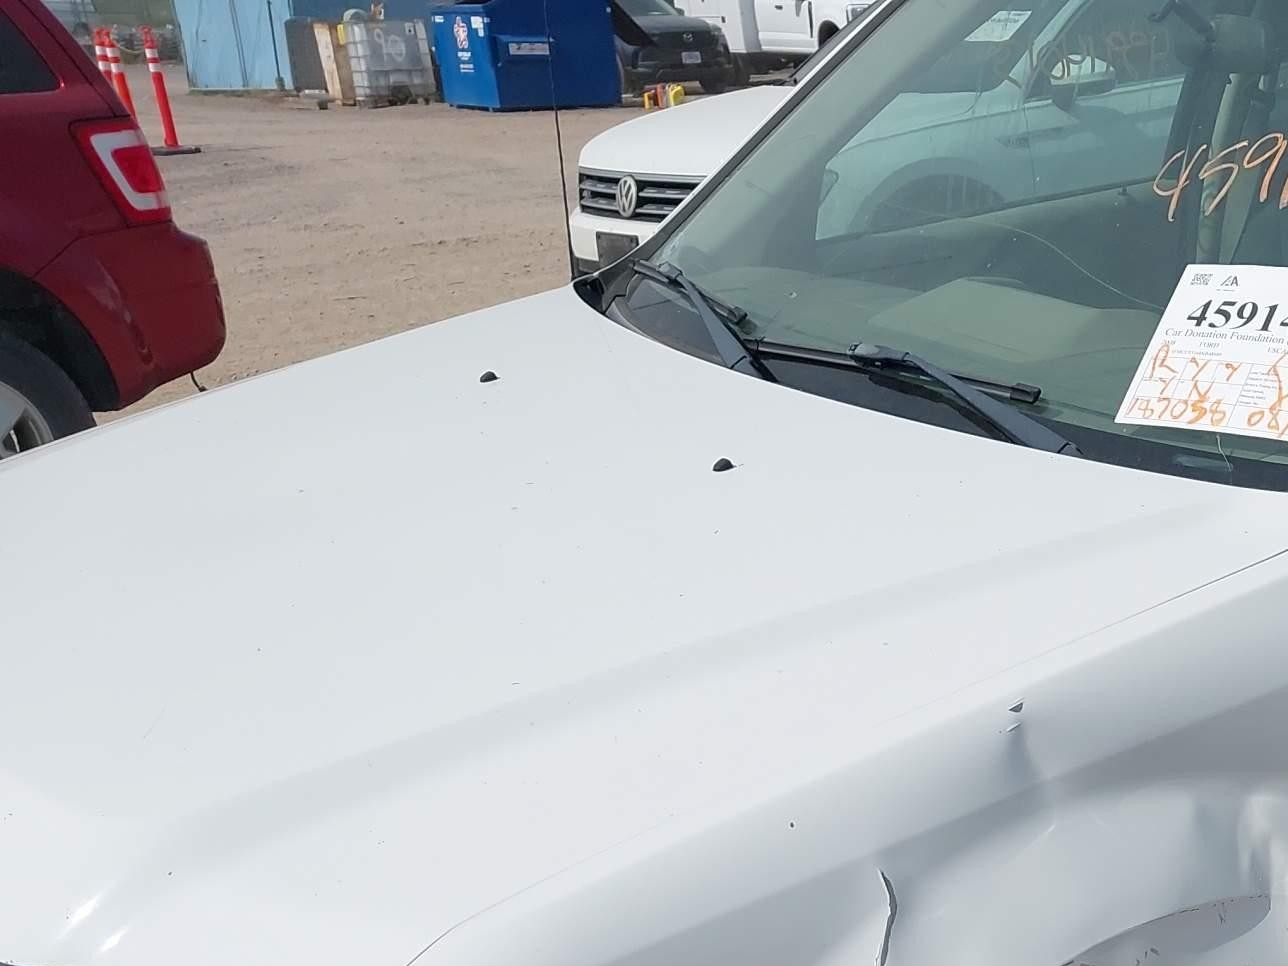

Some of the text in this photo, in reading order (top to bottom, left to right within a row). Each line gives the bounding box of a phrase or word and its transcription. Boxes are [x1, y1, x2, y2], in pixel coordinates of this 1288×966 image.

[1165, 327, 1183, 338] Car
[1184, 329, 1227, 340] Donation
[1230, 332, 1284, 345] Foundation
